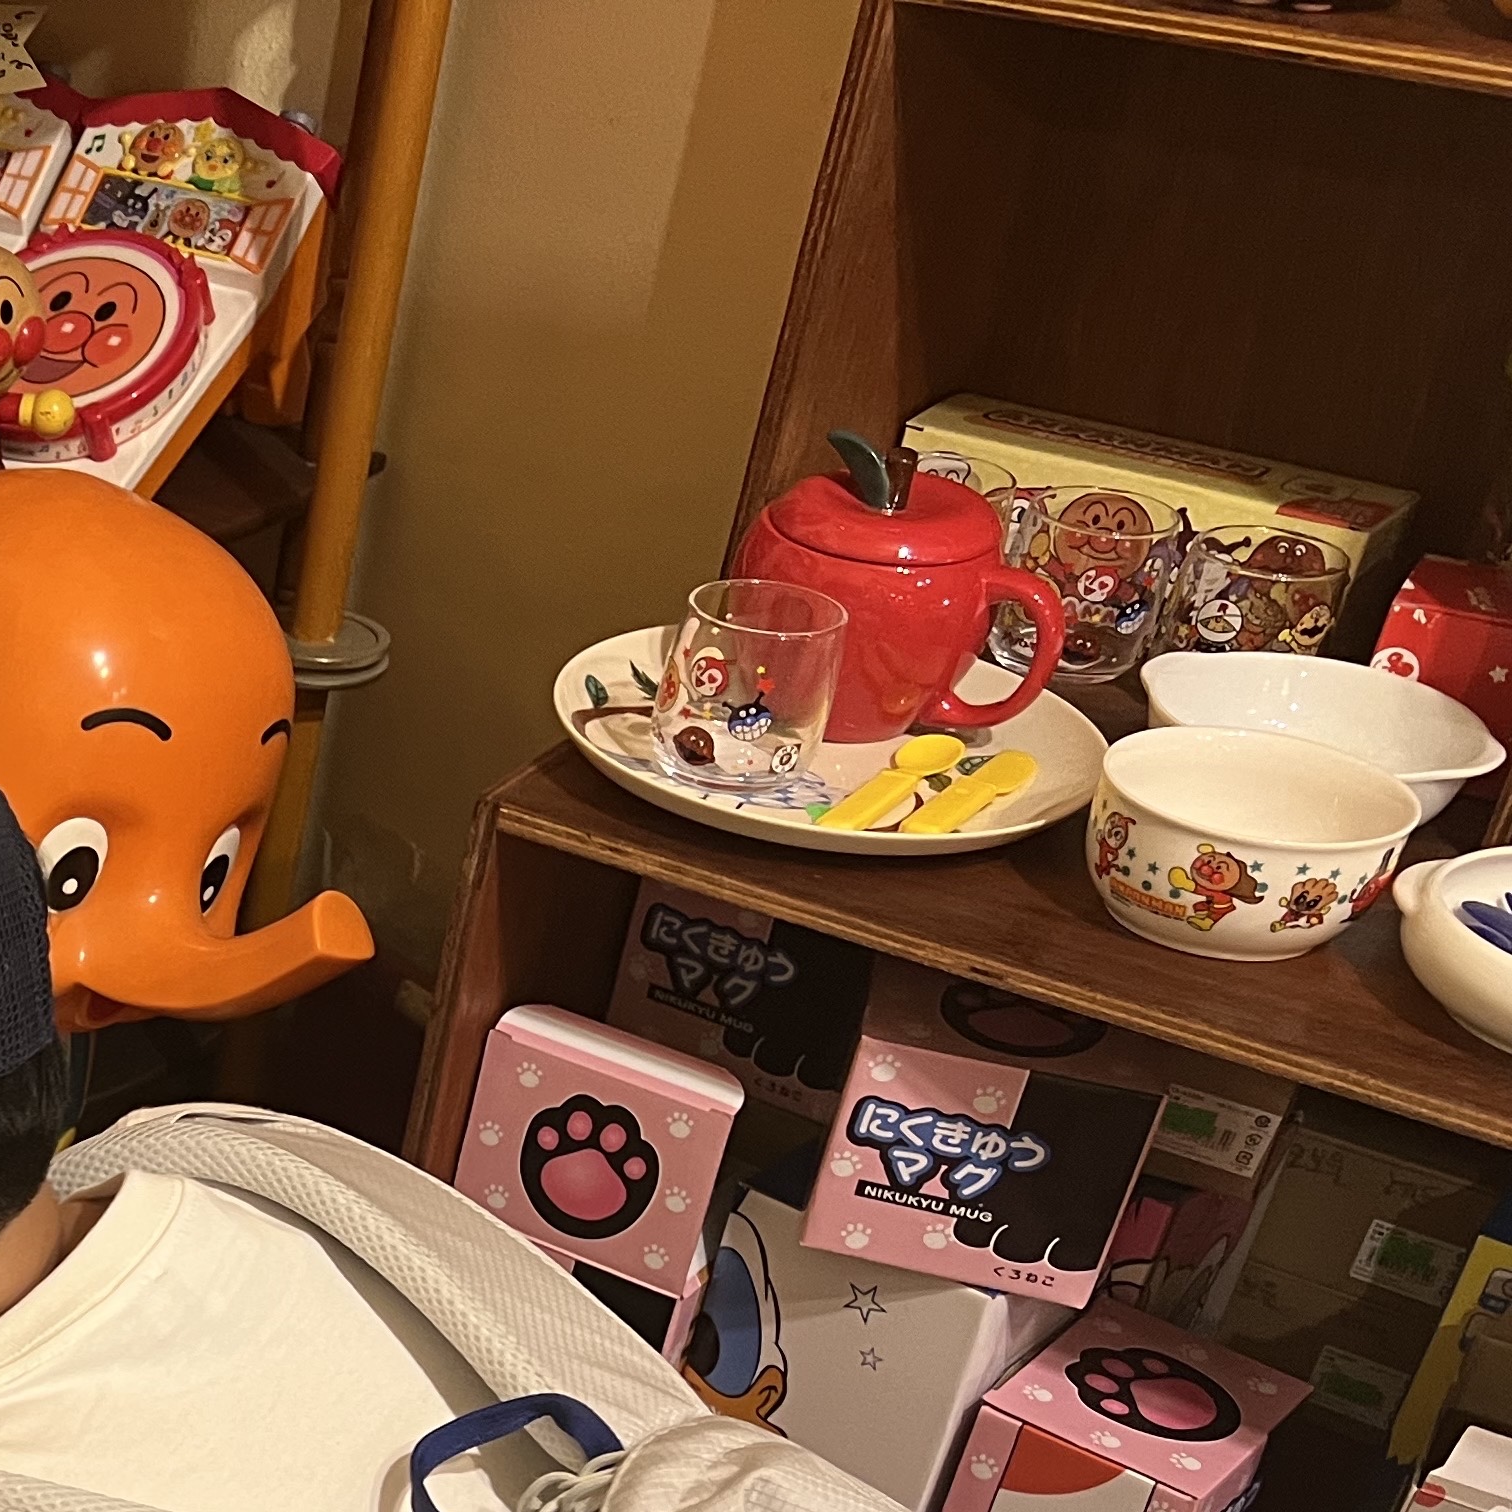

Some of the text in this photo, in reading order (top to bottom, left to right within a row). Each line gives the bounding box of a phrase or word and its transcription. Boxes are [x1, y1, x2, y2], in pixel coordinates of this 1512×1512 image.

[650, 911, 795, 982] にくきゅう
[653, 989, 754, 1034] NIKUKYU MUG
[859, 1103, 1046, 1168] にくきゅう
[892, 1150, 998, 1196] マグ
[863, 1184, 994, 1223] NIKUKYU MUG
[992, 1265, 1056, 1288] くろねこ
